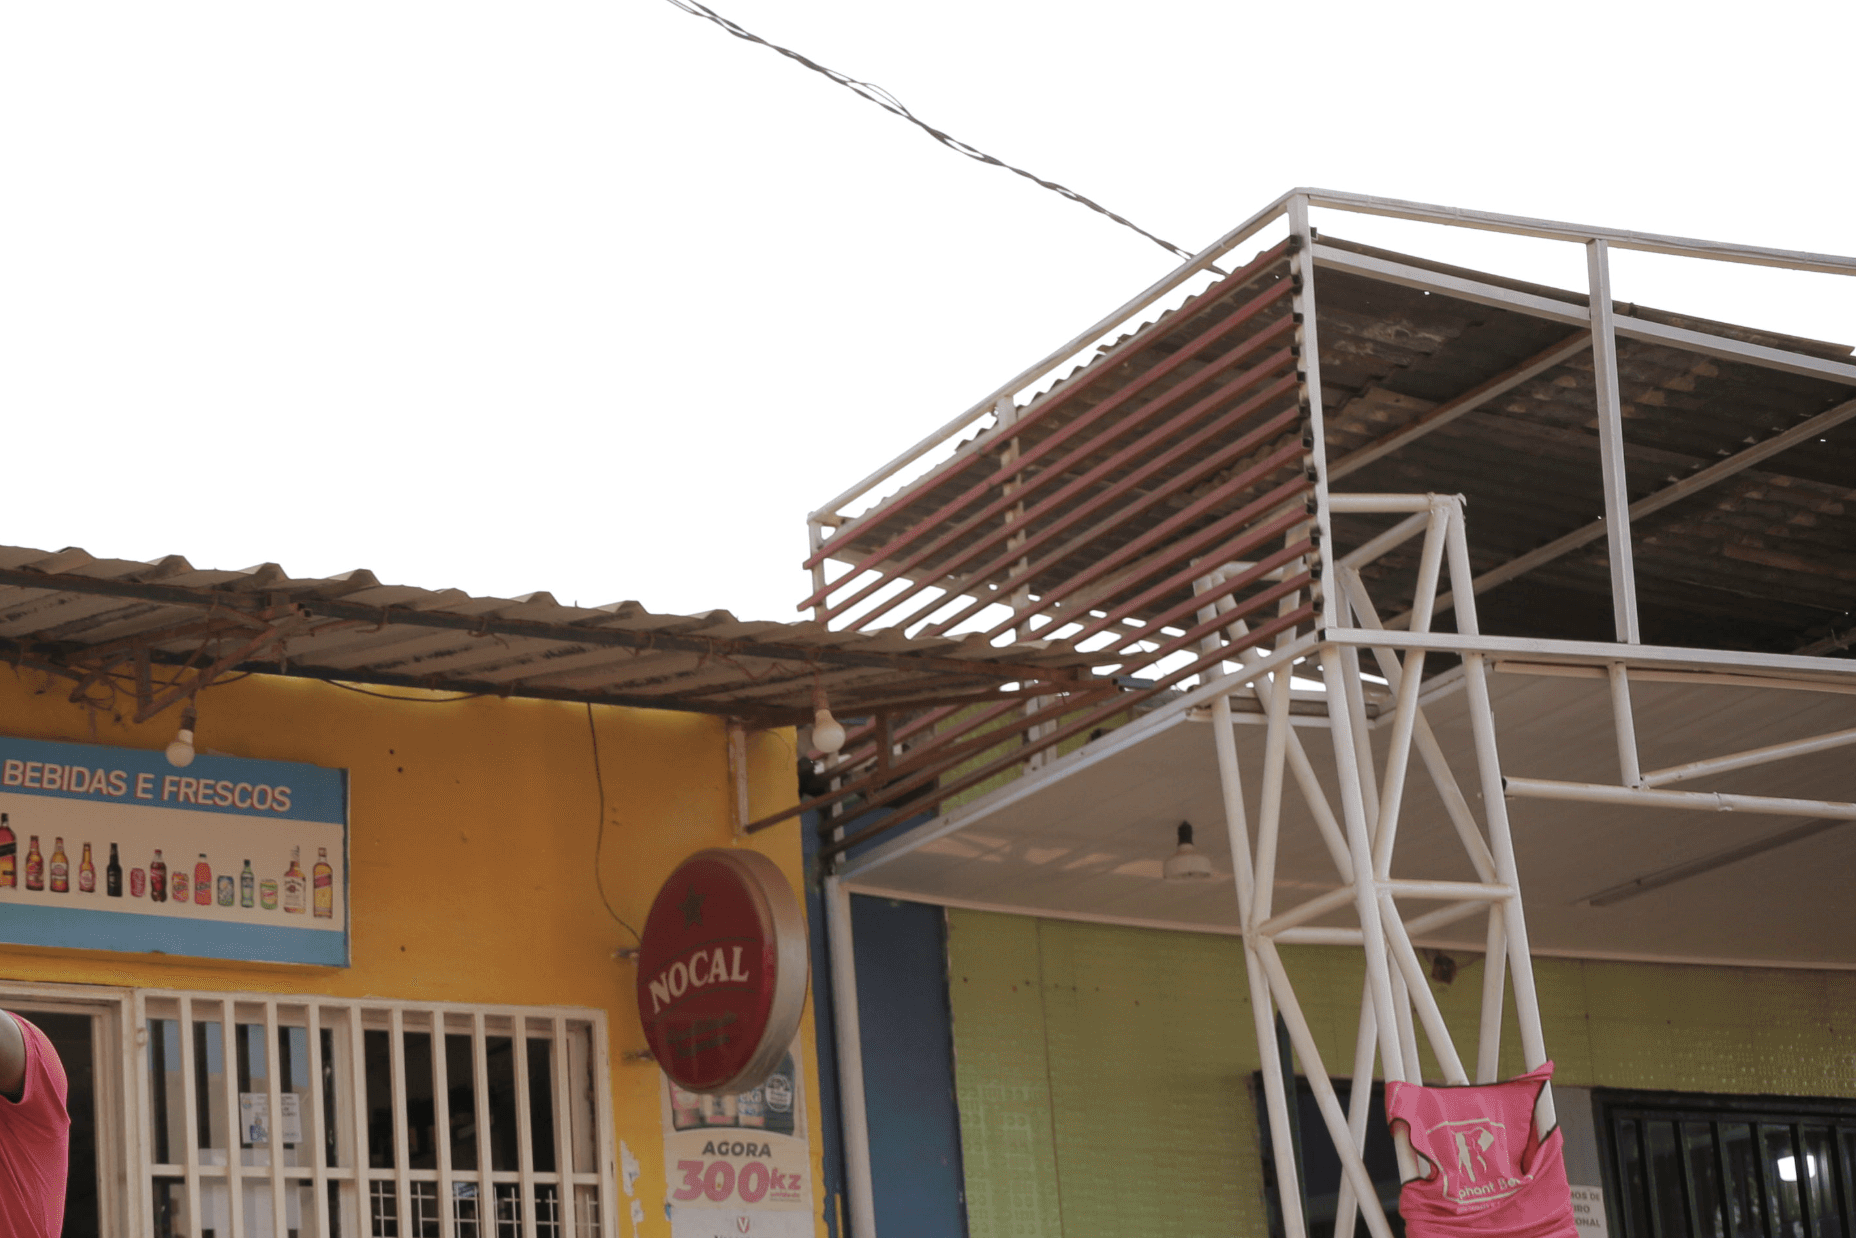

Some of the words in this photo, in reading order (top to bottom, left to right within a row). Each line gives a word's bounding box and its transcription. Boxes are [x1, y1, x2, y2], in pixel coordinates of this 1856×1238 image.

[1, 759, 128, 797] BEBIDAS
[134, 772, 155, 800] E
[161, 774, 292, 813] FRESCOS
[648, 945, 750, 1015] NOCAL
[701, 1140, 772, 1158] AGORA
